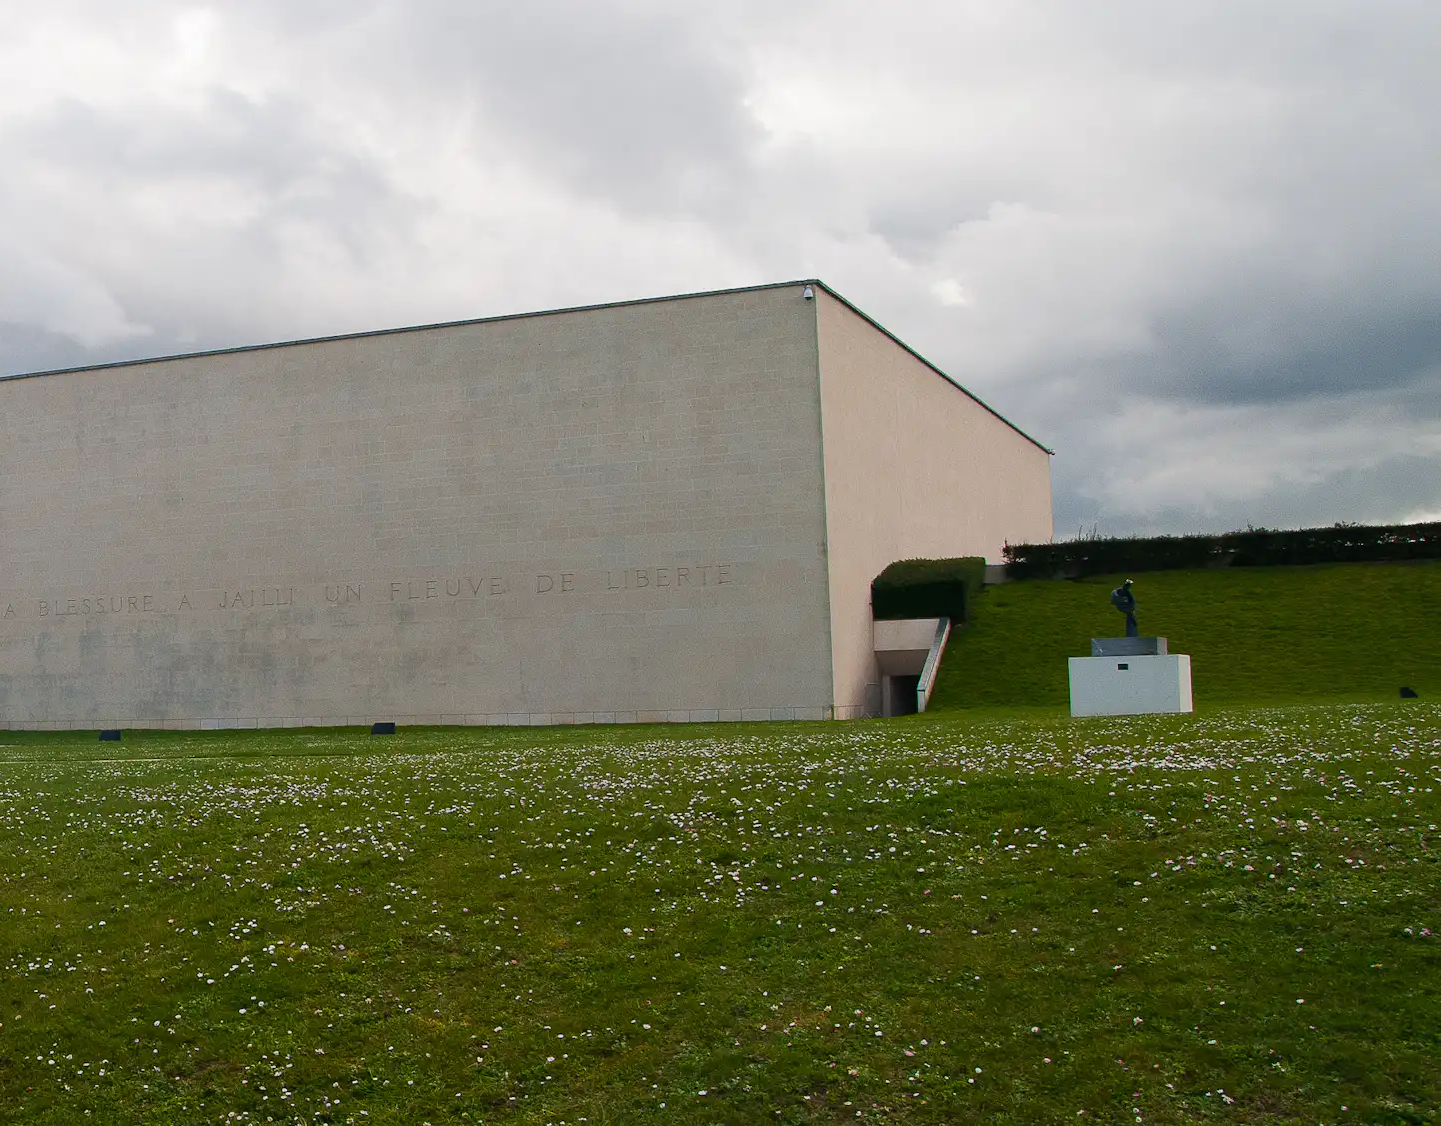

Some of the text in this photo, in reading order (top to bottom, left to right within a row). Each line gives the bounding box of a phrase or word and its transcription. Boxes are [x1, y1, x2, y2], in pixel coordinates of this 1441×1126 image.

[39, 595, 154, 617] BLESSURE
[219, 588, 296, 608] JAILLI
[325, 585, 361, 602] UN
[390, 577, 504, 600] FLEUVE
[536, 573, 575, 594] DE
[607, 564, 732, 590] LIBERTE
